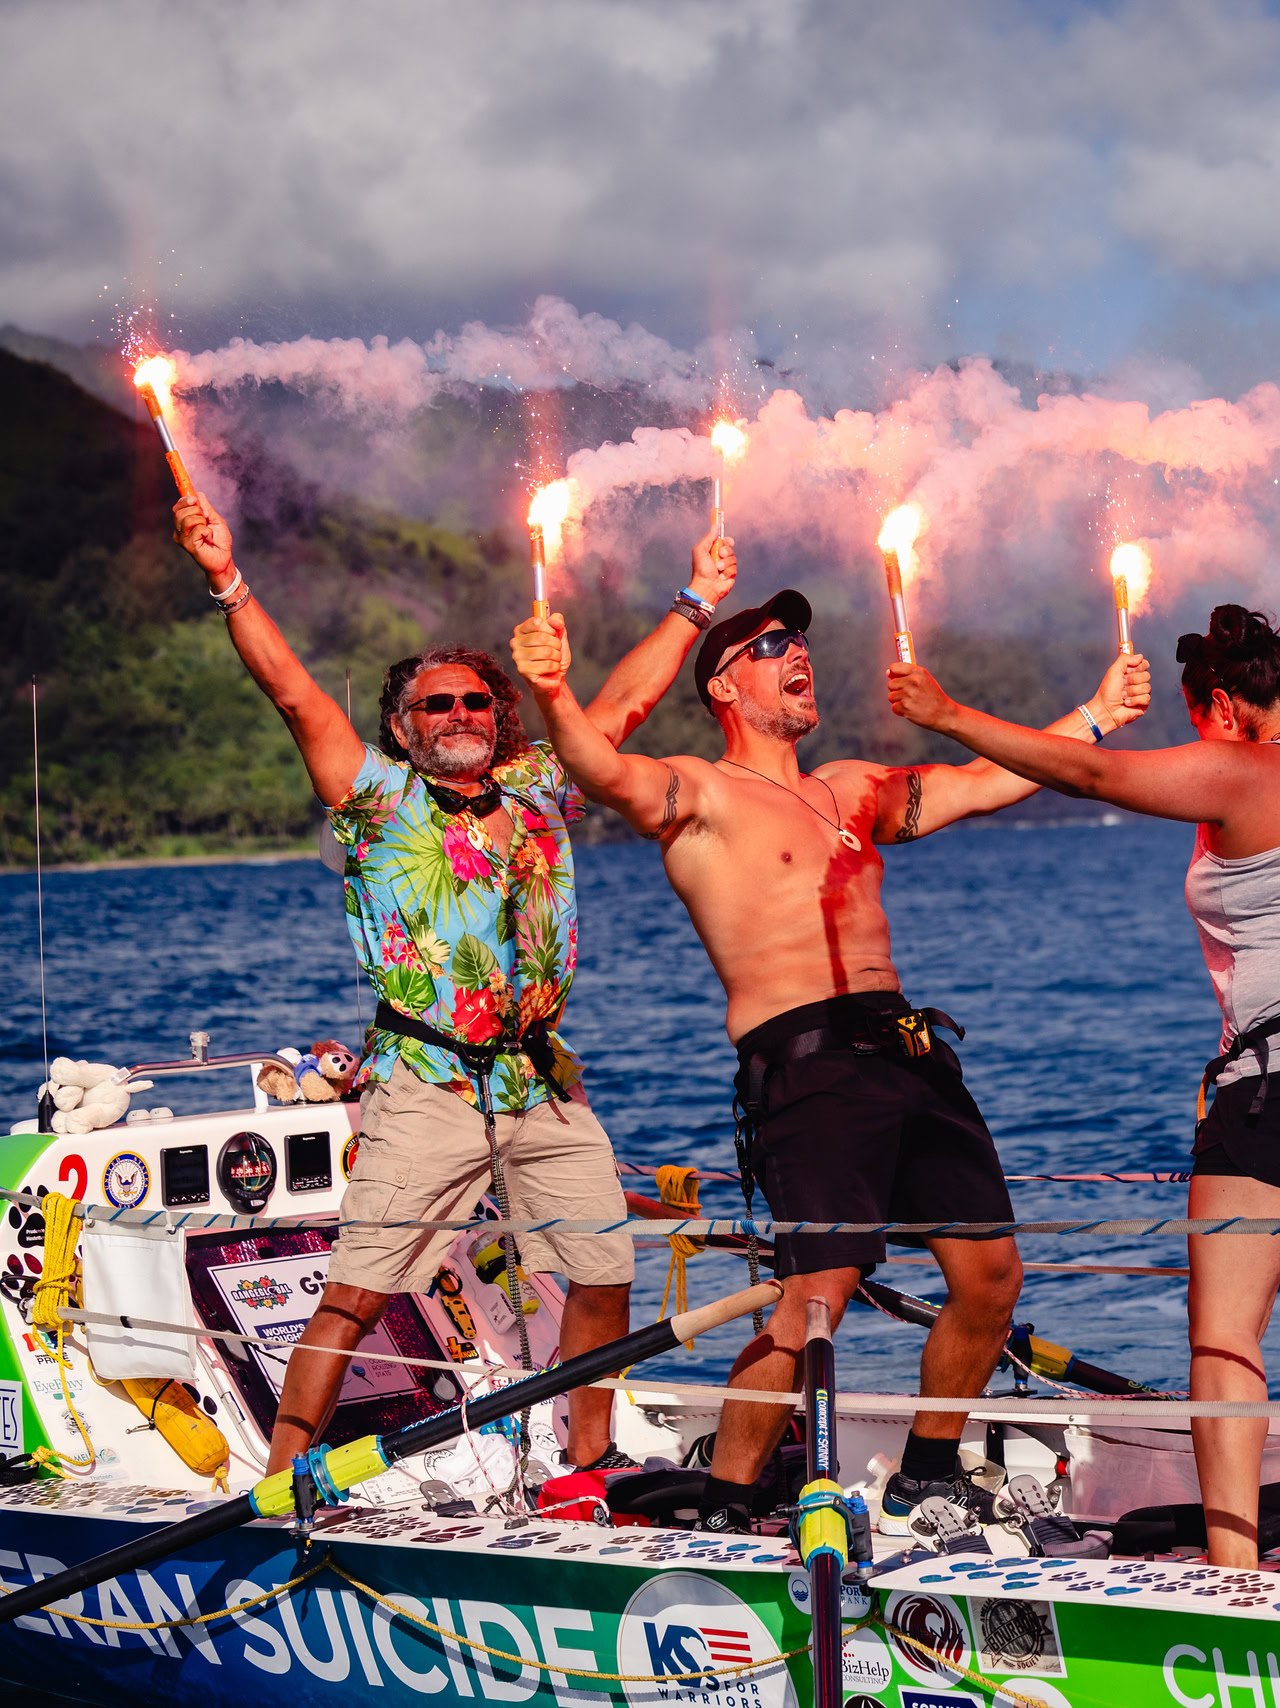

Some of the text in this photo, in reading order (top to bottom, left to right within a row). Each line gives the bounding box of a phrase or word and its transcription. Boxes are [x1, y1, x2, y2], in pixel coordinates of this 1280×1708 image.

[262, 1323, 306, 1337] WORLD'S
[0, 1397, 17, 1441] ES
[817, 1437, 830, 1470] SKINNY
[225, 1578, 608, 1708] SUICIDE
[988, 1613, 1039, 1651] BOURBON
[658, 1687, 763, 1708] WARRIORS
[725, 1682, 760, 1695] FOR
